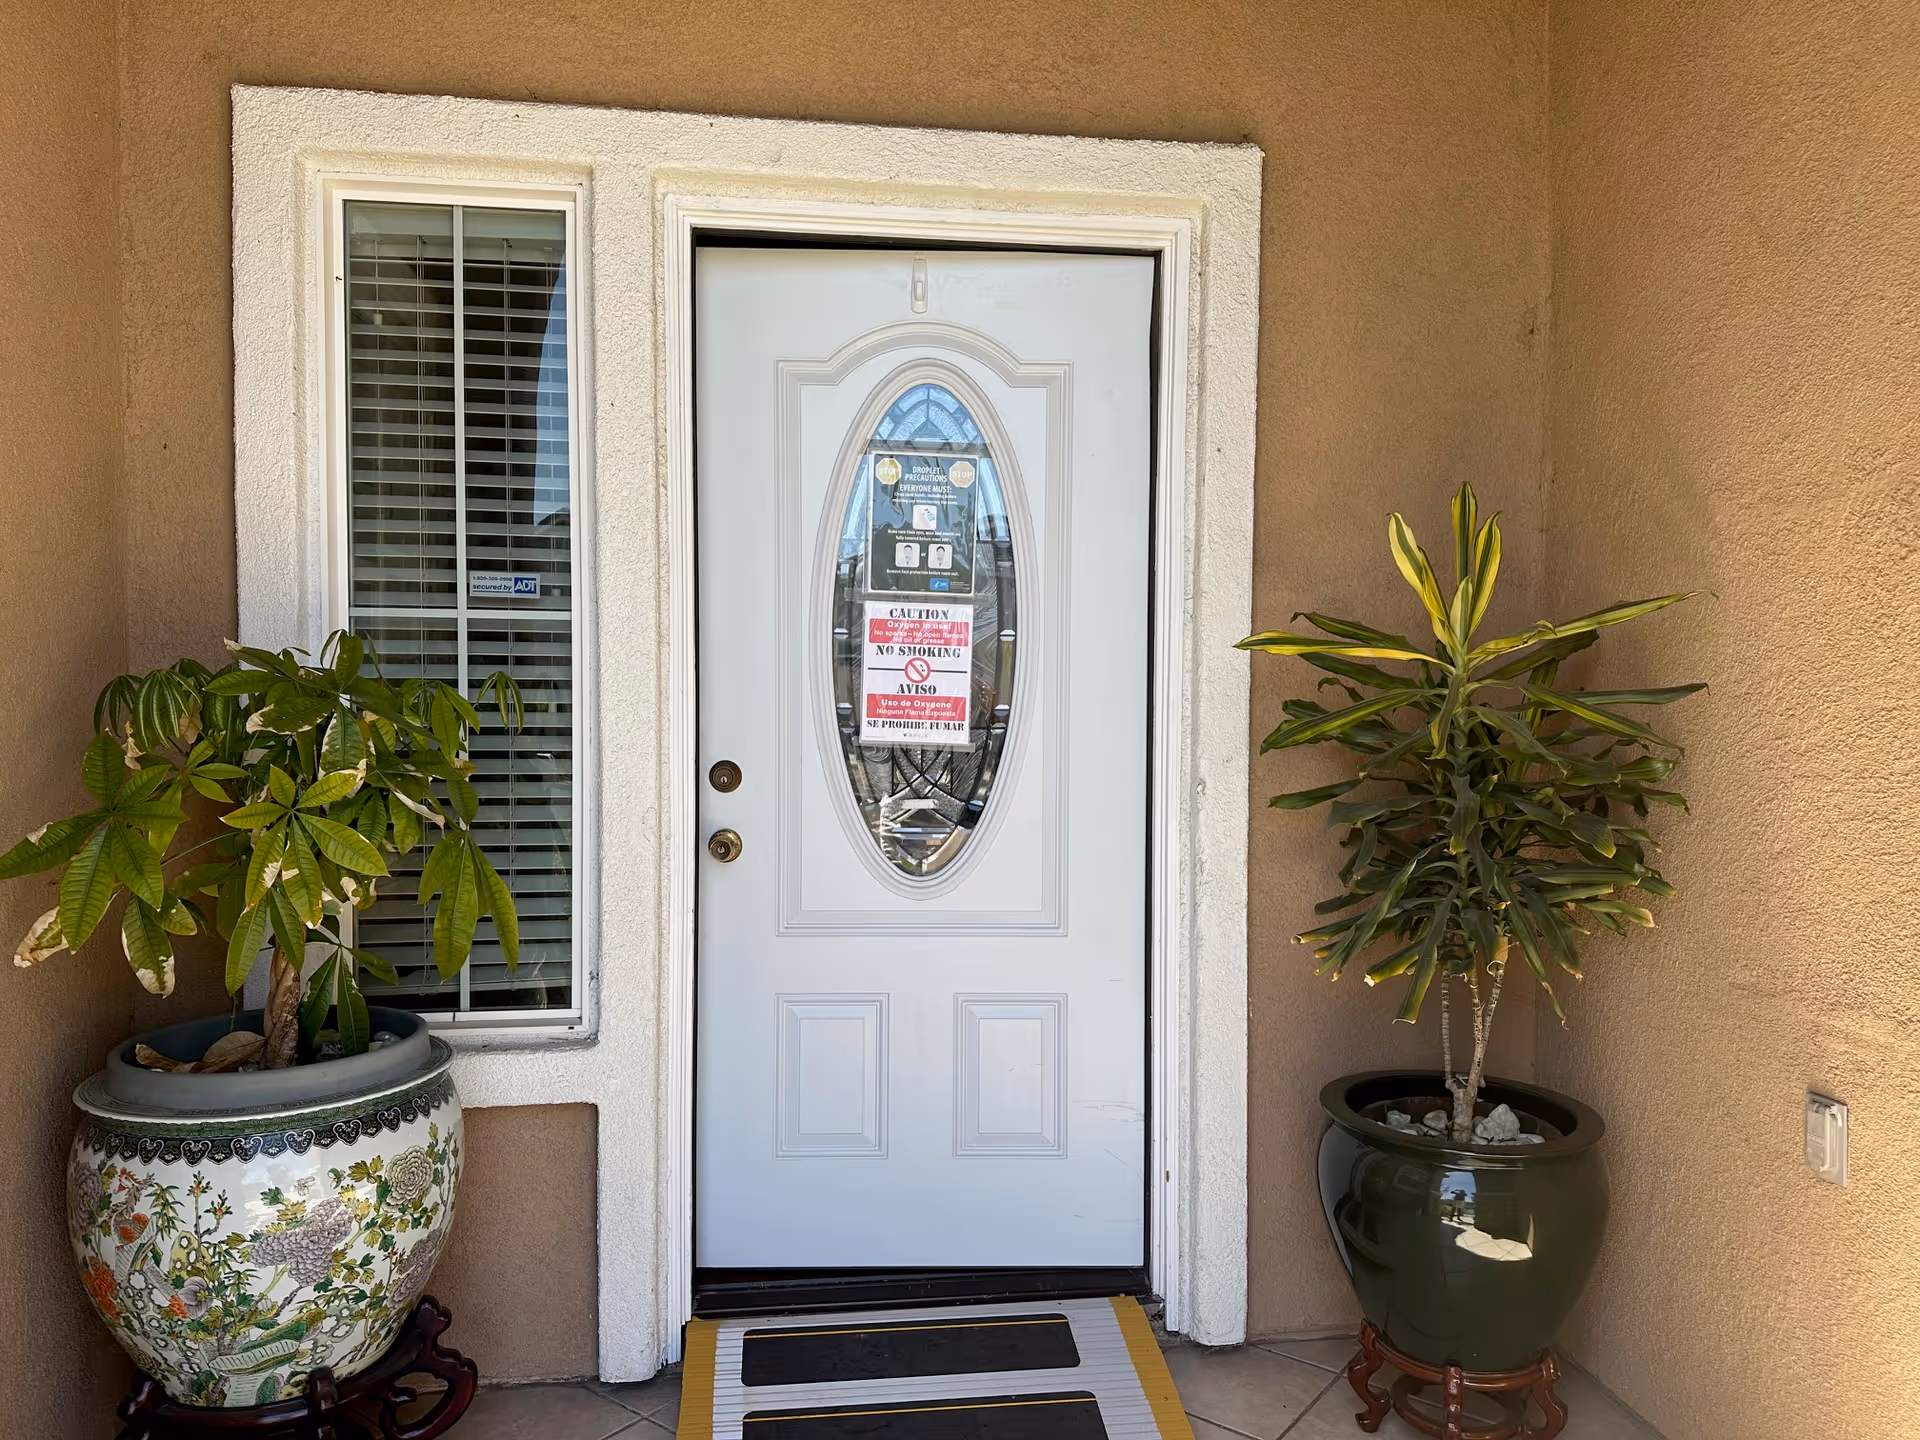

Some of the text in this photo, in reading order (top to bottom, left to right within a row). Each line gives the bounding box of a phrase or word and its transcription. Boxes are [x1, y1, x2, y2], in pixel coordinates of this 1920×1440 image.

[913, 466, 940, 474] DROPLET
[905, 474, 948, 482] PRECAUTIONS
[900, 484, 931, 492] EVERYONE
[514, 580, 536, 591] ADT
[890, 608, 950, 620] CAUTION
[887, 621, 920, 629] Oxygen
[876, 645, 960, 658] NO SMOKING
[897, 684, 936, 695] AVISO
[867, 720, 964, 731] SE PROHIBE FUMAR
